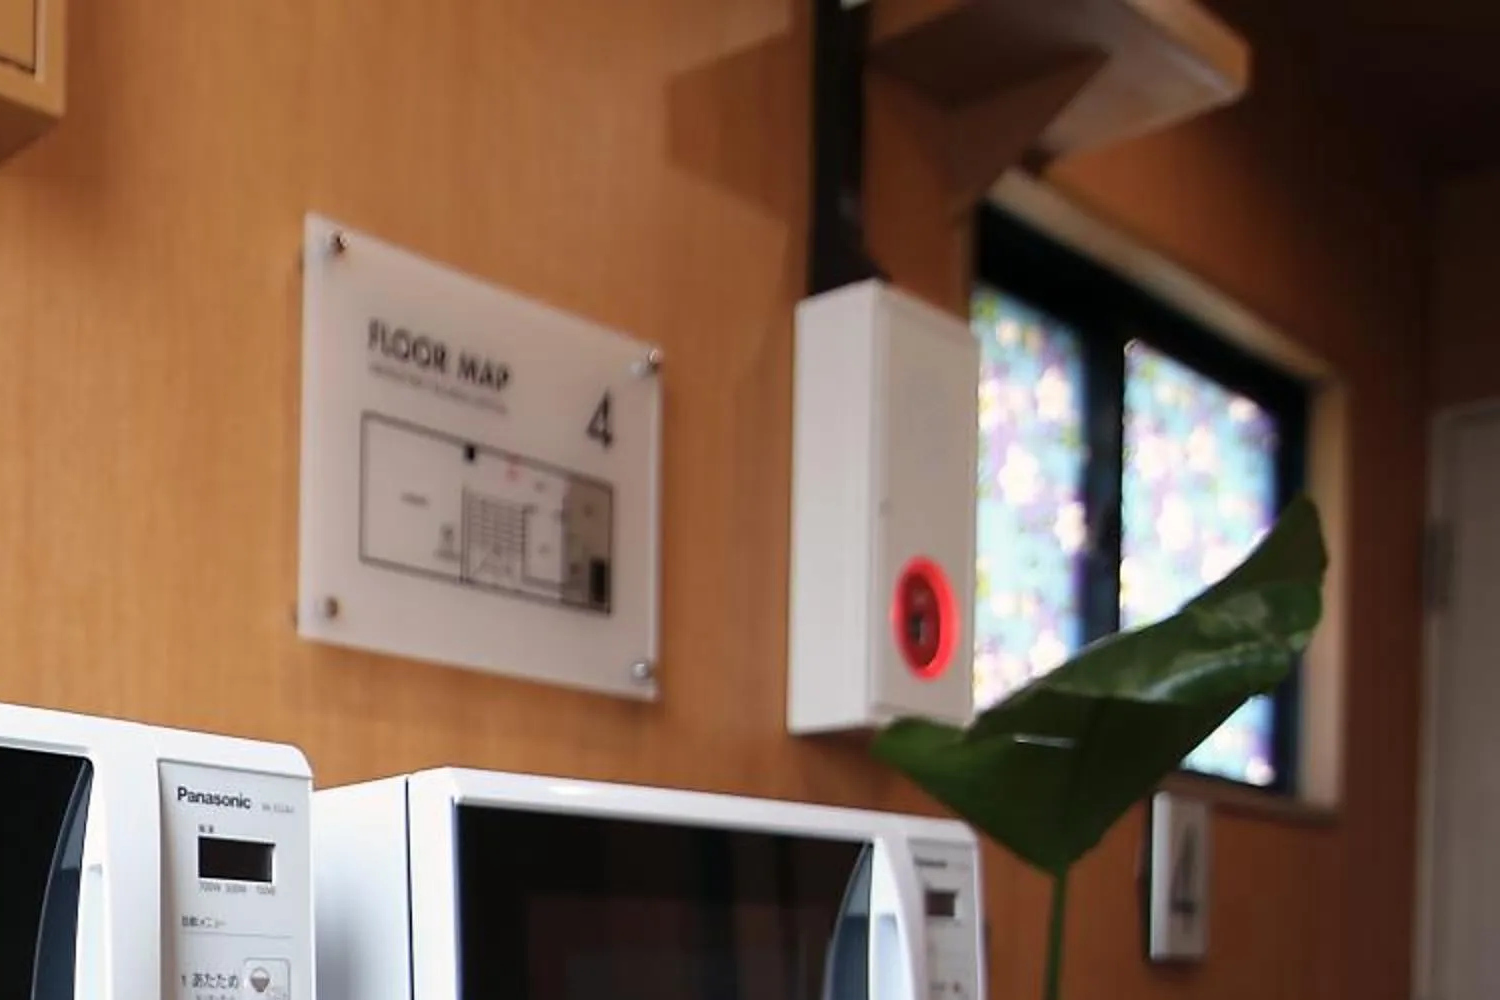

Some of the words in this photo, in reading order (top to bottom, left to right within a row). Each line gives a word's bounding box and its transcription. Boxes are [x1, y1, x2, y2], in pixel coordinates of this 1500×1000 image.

[368, 317, 447, 374] FLOOR
[456, 352, 510, 391] MAP
[585, 387, 614, 449] 4
[177, 786, 251, 809] Panasonic
[192, 972, 238, 989] あたため
